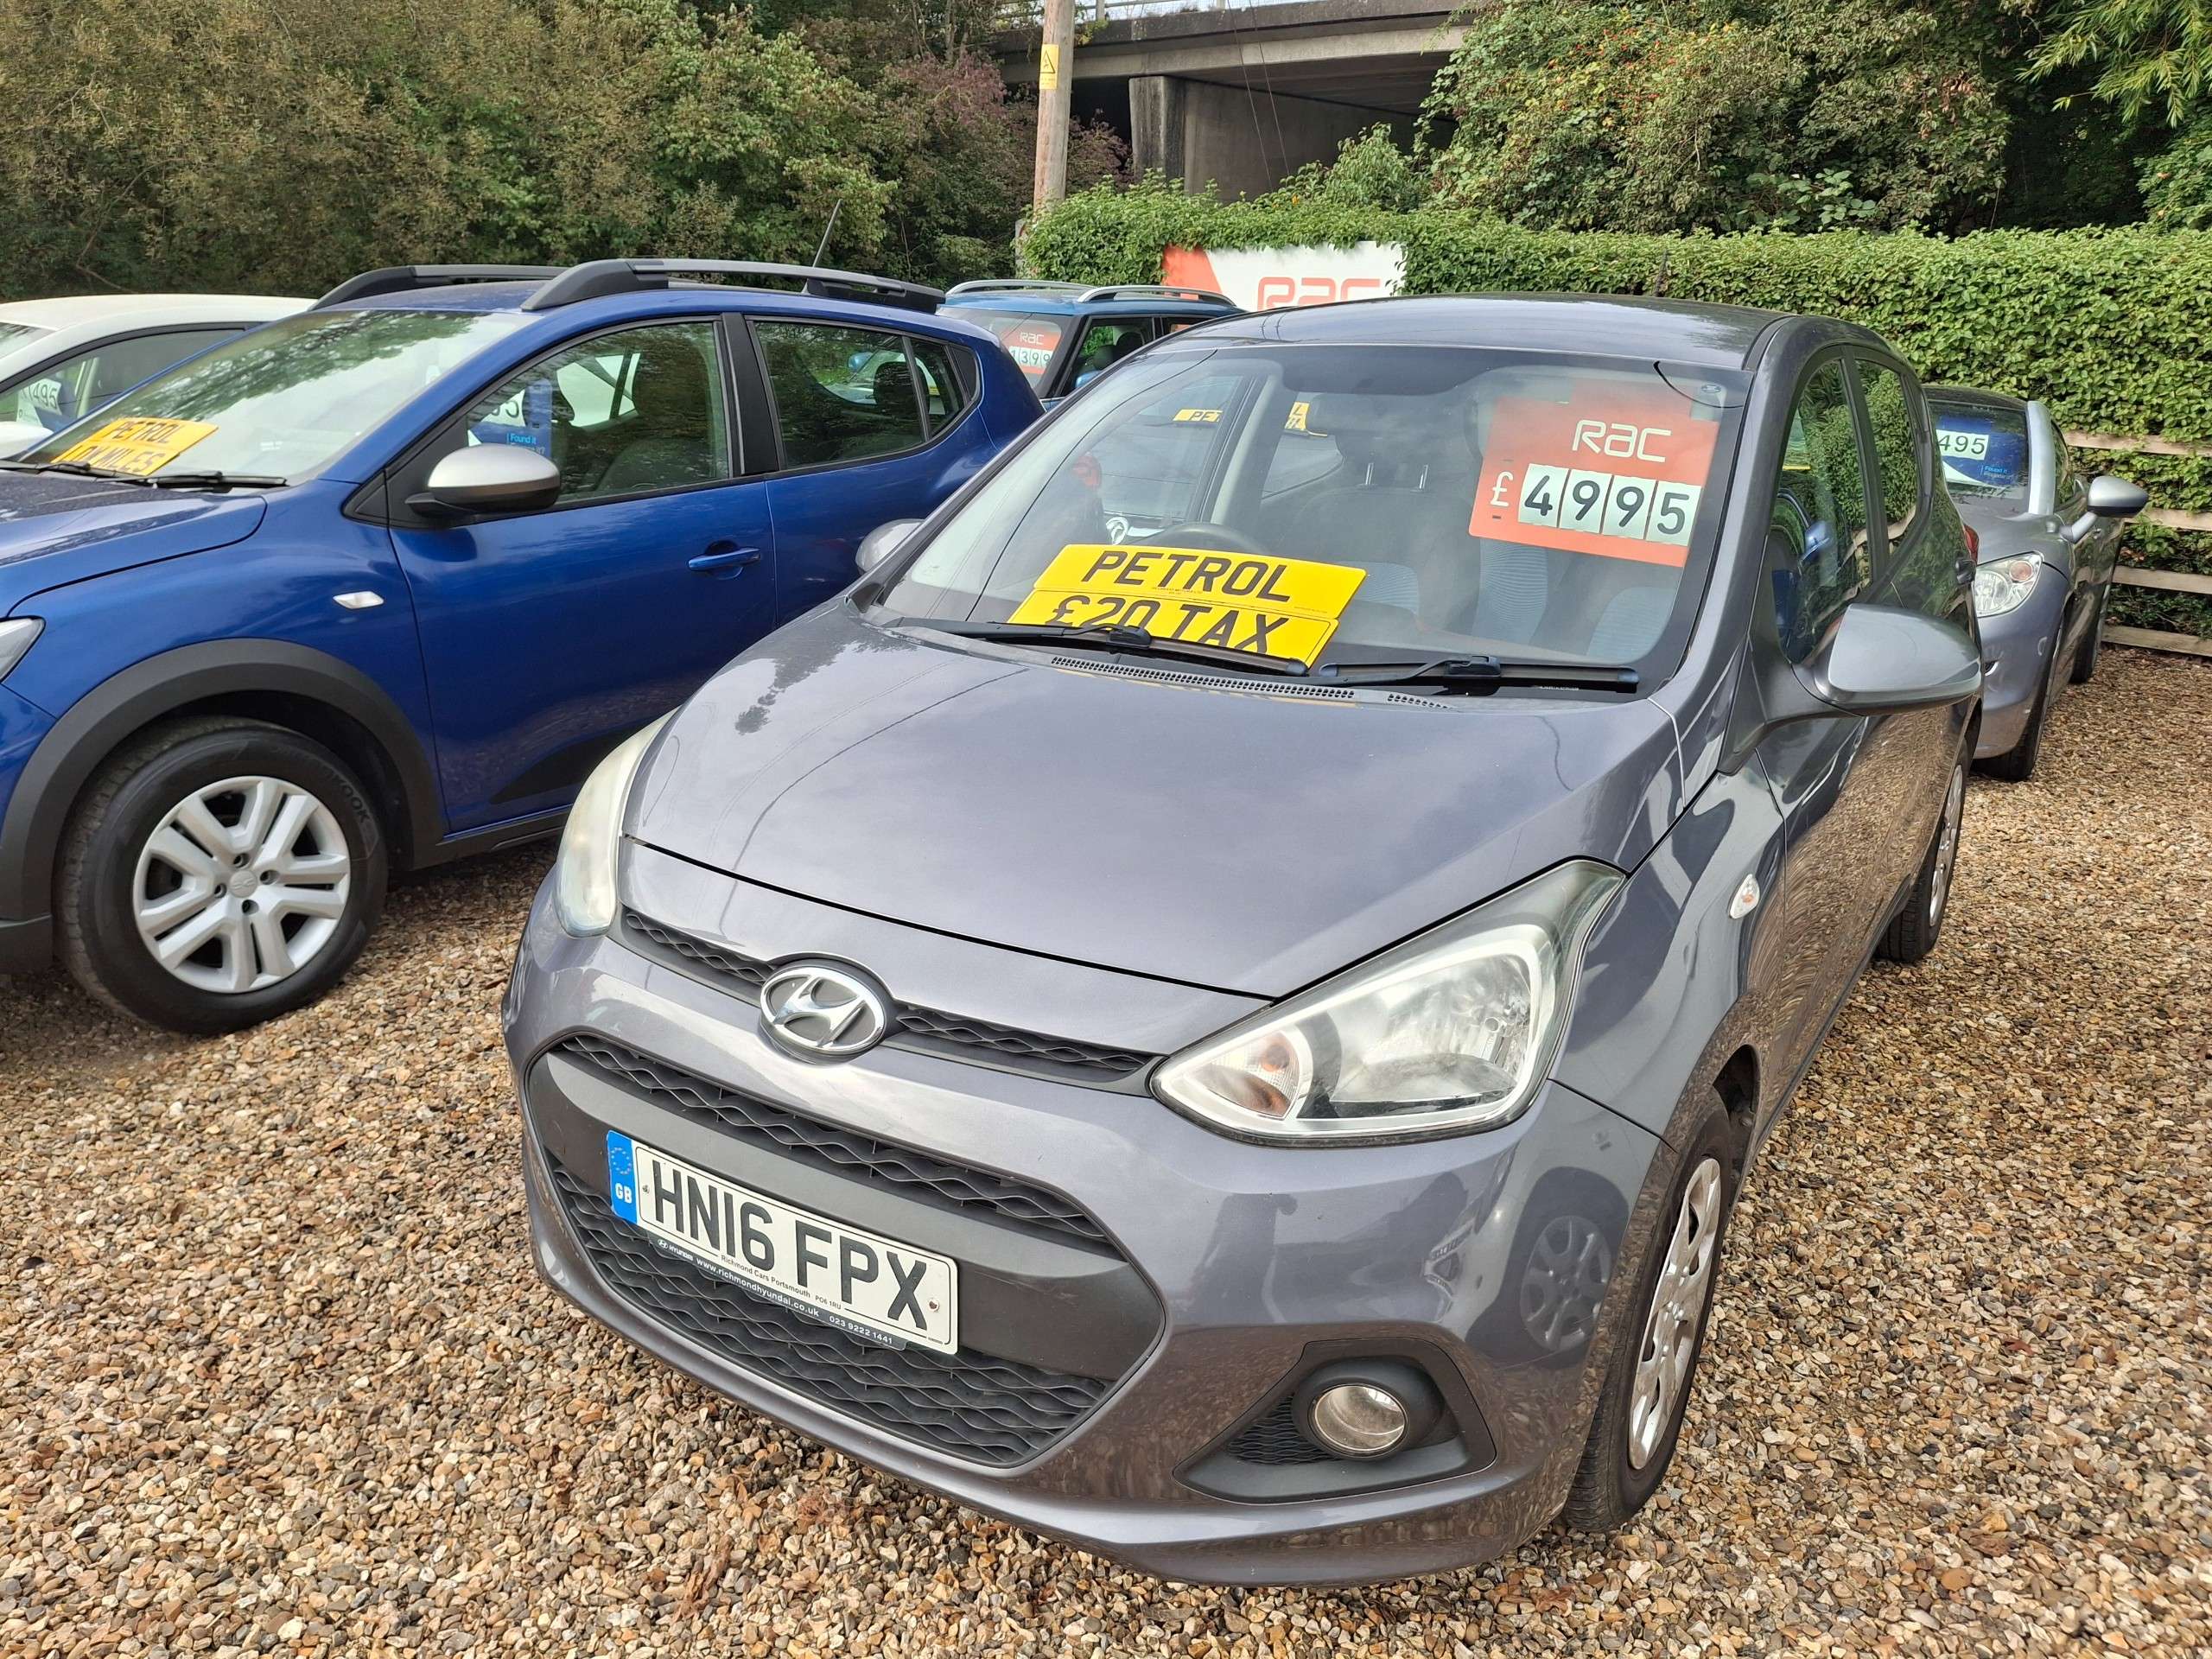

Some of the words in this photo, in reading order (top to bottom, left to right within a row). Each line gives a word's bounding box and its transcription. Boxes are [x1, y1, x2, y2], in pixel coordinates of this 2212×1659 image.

[103, 420, 186, 443] PETROL
[1081, 550, 1291, 602] PETROL
[1046, 595, 1160, 632] £20
[1171, 604, 1289, 654] TAX
[615, 1182, 632, 1204] GB
[652, 1159, 775, 1272] HN16
[795, 1219, 928, 1332] FPX
[696, 1257, 820, 1317] www.richmondhyundai.co.uk
[830, 1315, 846, 1327] 023
[848, 1322, 870, 1336] 9222
[872, 1332, 893, 1344] 1441
[721, 1255, 753, 1274] Richmond
[754, 1269, 770, 1282] Cars
[771, 1275, 811, 1298] Portsmouth
[815, 1294, 828, 1306] PO6
